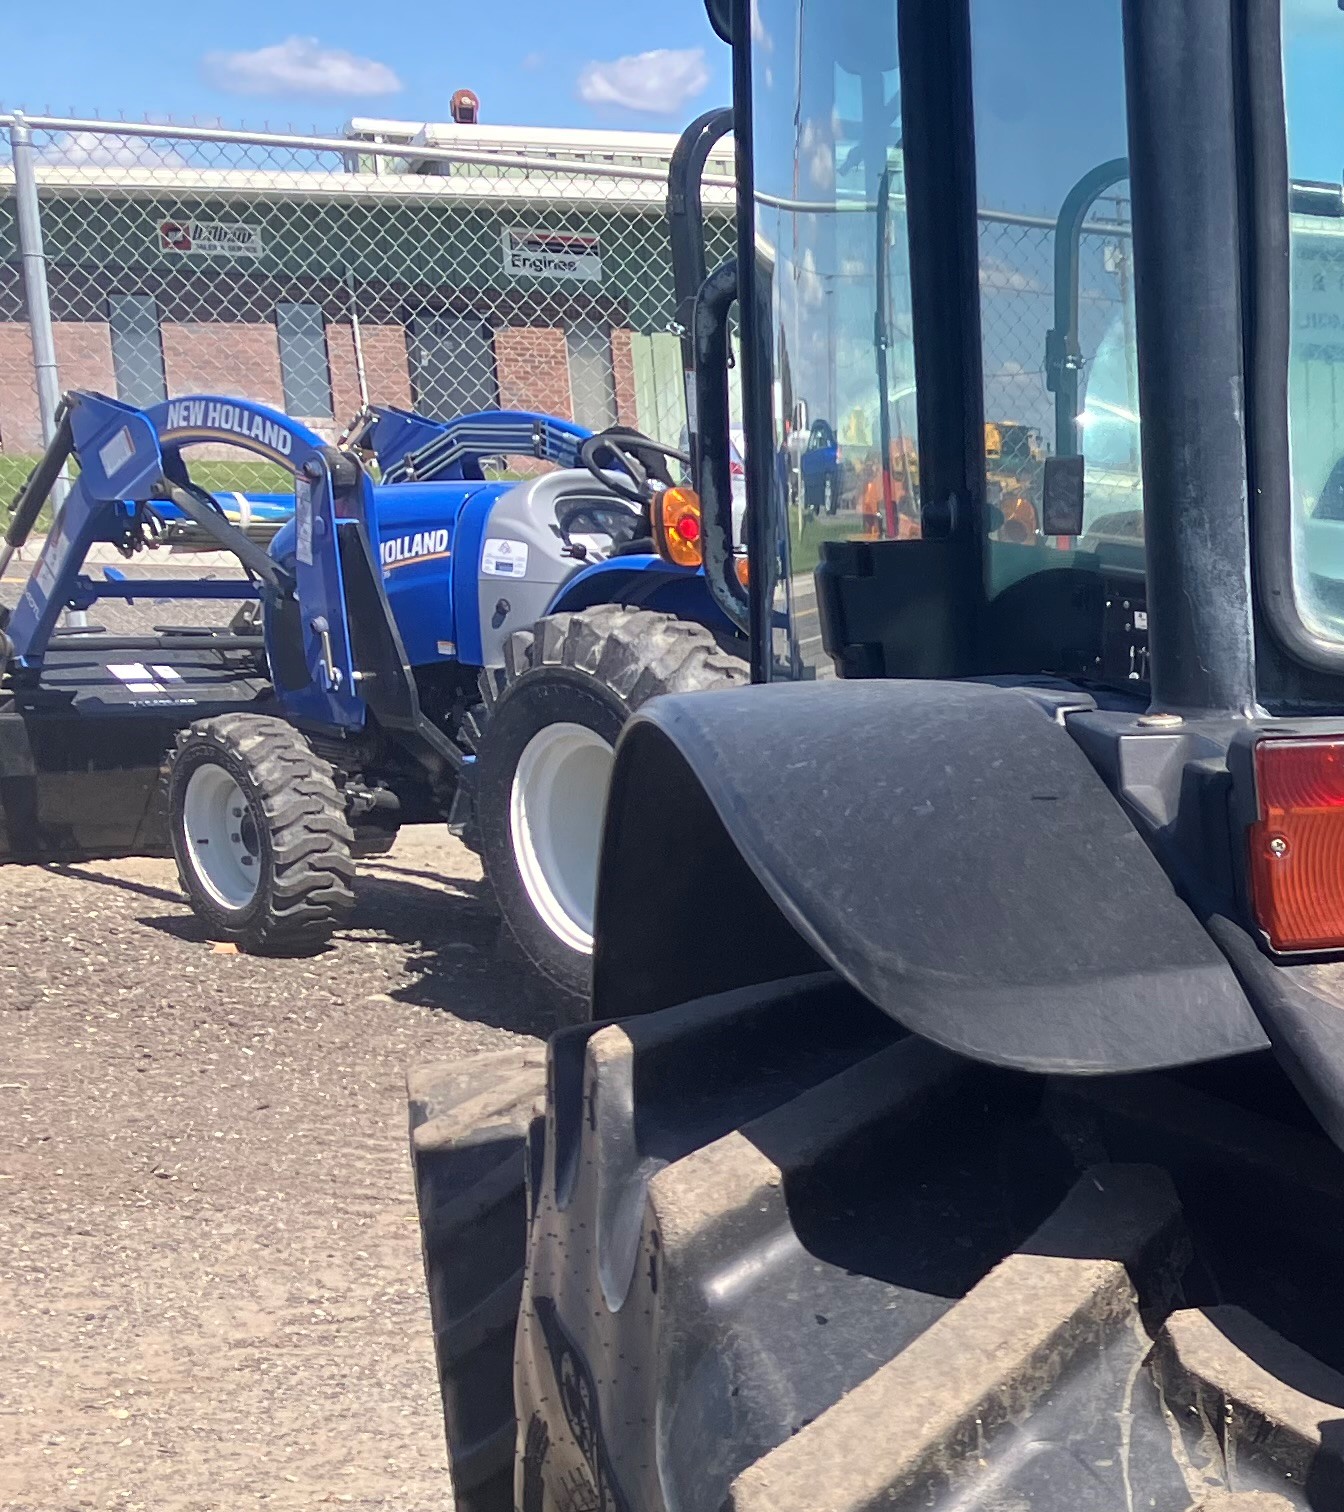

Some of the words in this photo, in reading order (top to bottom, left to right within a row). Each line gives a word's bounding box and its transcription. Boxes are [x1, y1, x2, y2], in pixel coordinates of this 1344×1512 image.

[511, 253, 578, 273] Engines
[167, 400, 206, 430] NEW
[207, 402, 292, 456] HOLLAND
